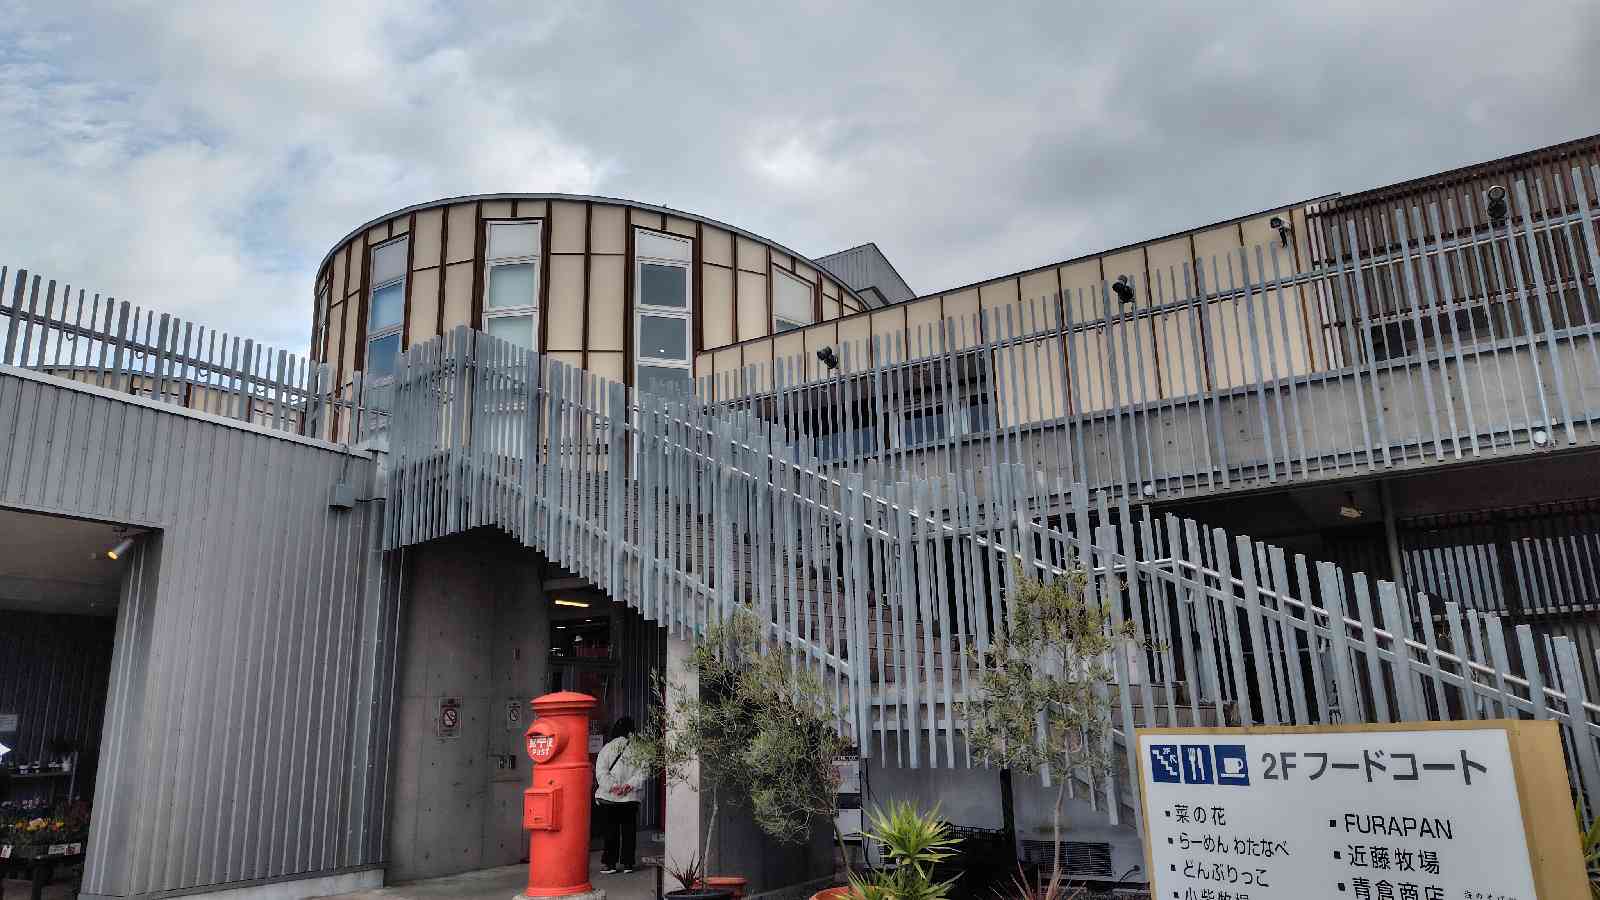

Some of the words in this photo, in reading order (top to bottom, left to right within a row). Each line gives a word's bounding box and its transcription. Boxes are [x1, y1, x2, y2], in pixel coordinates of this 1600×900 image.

[1175, 804, 1226, 826] 菜の花
[1344, 813, 1453, 840] FURAPAN
[1180, 832, 1228, 853] らーめん
[1234, 836, 1289, 857] わたなべ
[1348, 845, 1440, 875] 近藤牧場
[1183, 860, 1270, 887] どんぶりっこ
[1352, 876, 1444, 900] 青倉商店
